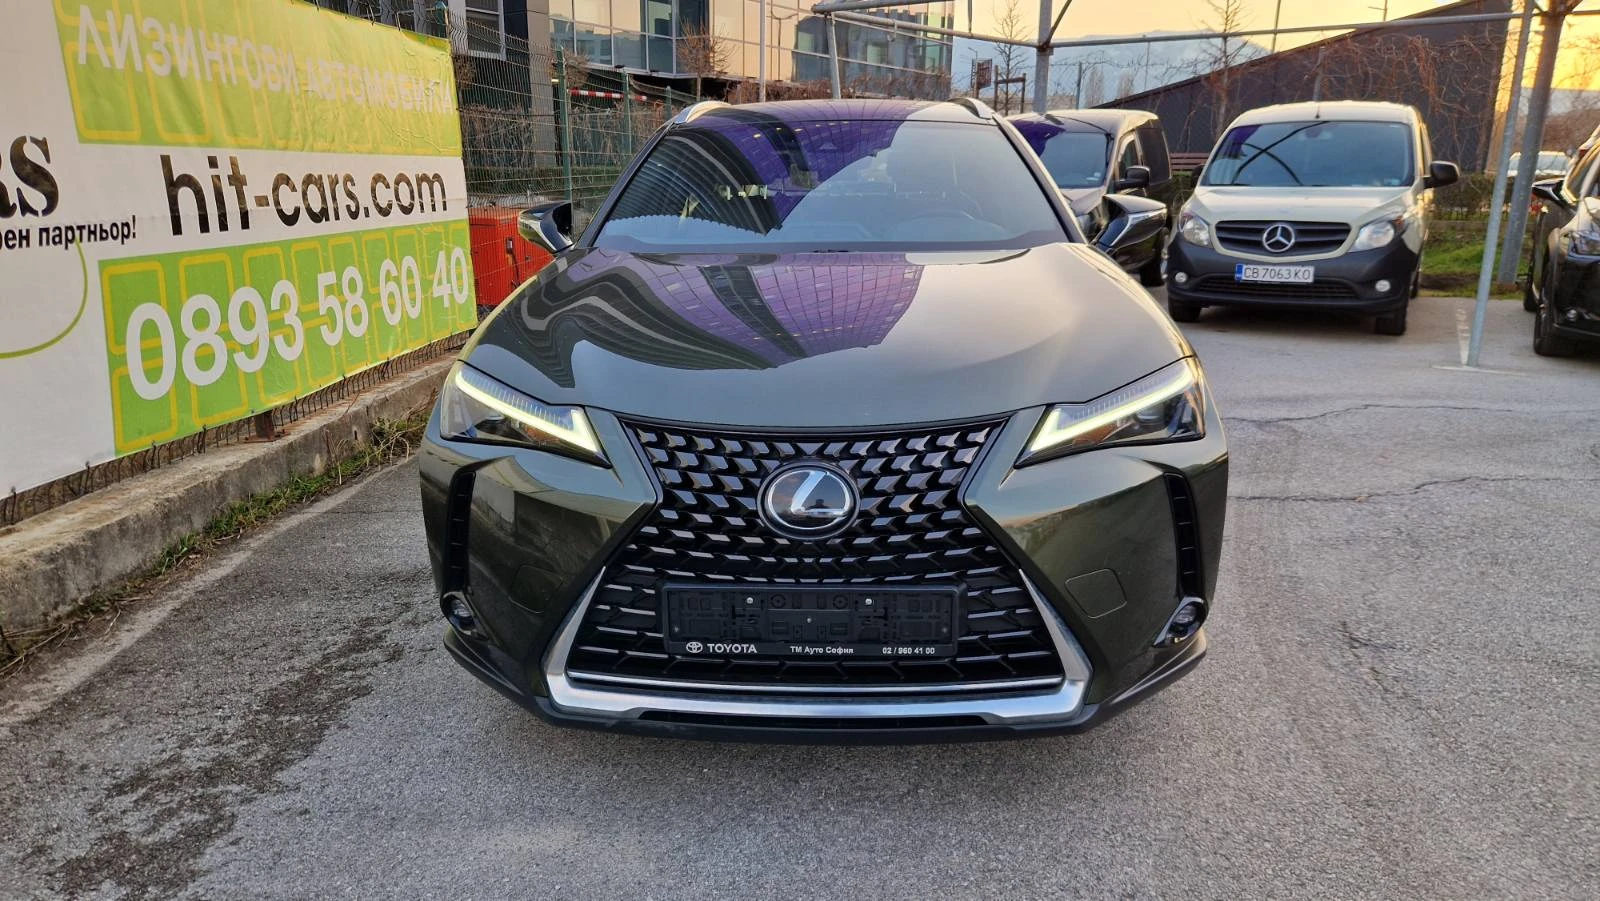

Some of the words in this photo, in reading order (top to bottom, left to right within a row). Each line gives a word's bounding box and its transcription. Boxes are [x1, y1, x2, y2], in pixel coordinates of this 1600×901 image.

[79, 4, 299, 96] ЛИЗИНГОВИ
[160, 154, 447, 237] hit-cars.com
[0, 227, 31, 251] ен
[39, 214, 136, 250] партньор!
[126, 279, 304, 401] 0893
[317, 266, 369, 346] 58
[379, 255, 422, 326] 60
[433, 246, 469, 309] 40
[707, 643, 757, 653] TOYOTA
[804, 646, 824, 655] Ауто
[825, 646, 854, 655] София
